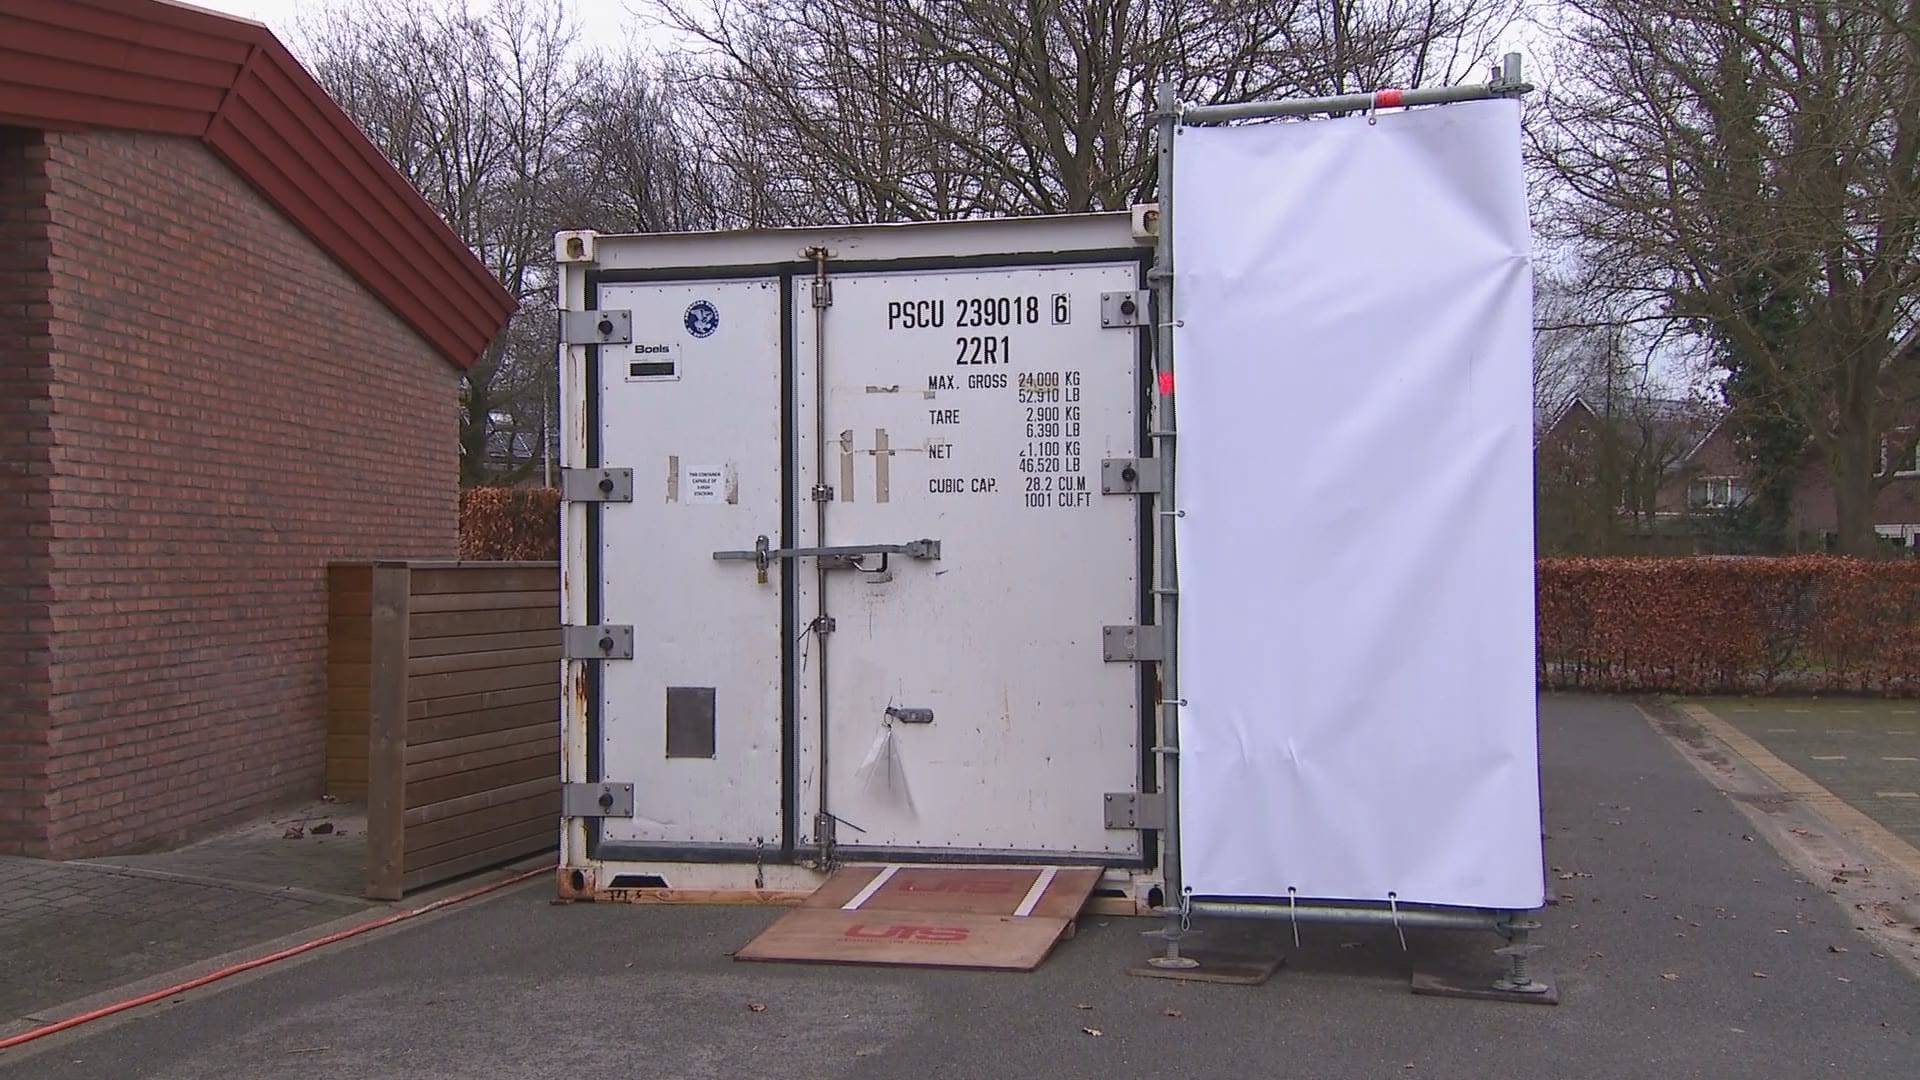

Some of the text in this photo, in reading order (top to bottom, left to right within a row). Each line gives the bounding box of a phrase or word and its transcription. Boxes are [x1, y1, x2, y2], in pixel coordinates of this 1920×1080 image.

[888, 295, 1069, 329] PSCU 239018 6
[956, 336, 1009, 365] 22R1
[928, 375, 960, 390] MAX.
[968, 374, 1008, 389] GROSS
[1065, 371, 1080, 386] KG
[1065, 387, 1080, 402] LB
[928, 409, 960, 424] TARE
[1065, 406, 1080, 421] KG
[1065, 422, 1080, 437] LB
[929, 444, 953, 459] NET
[1065, 441, 1080, 456] KG
[1065, 457, 1080, 472] LB
[929, 478, 964, 493] CUBIC
[971, 478, 999, 493] CAP.
[1025, 476, 1052, 491] 28.2
[1025, 492, 1051, 507] 1001
